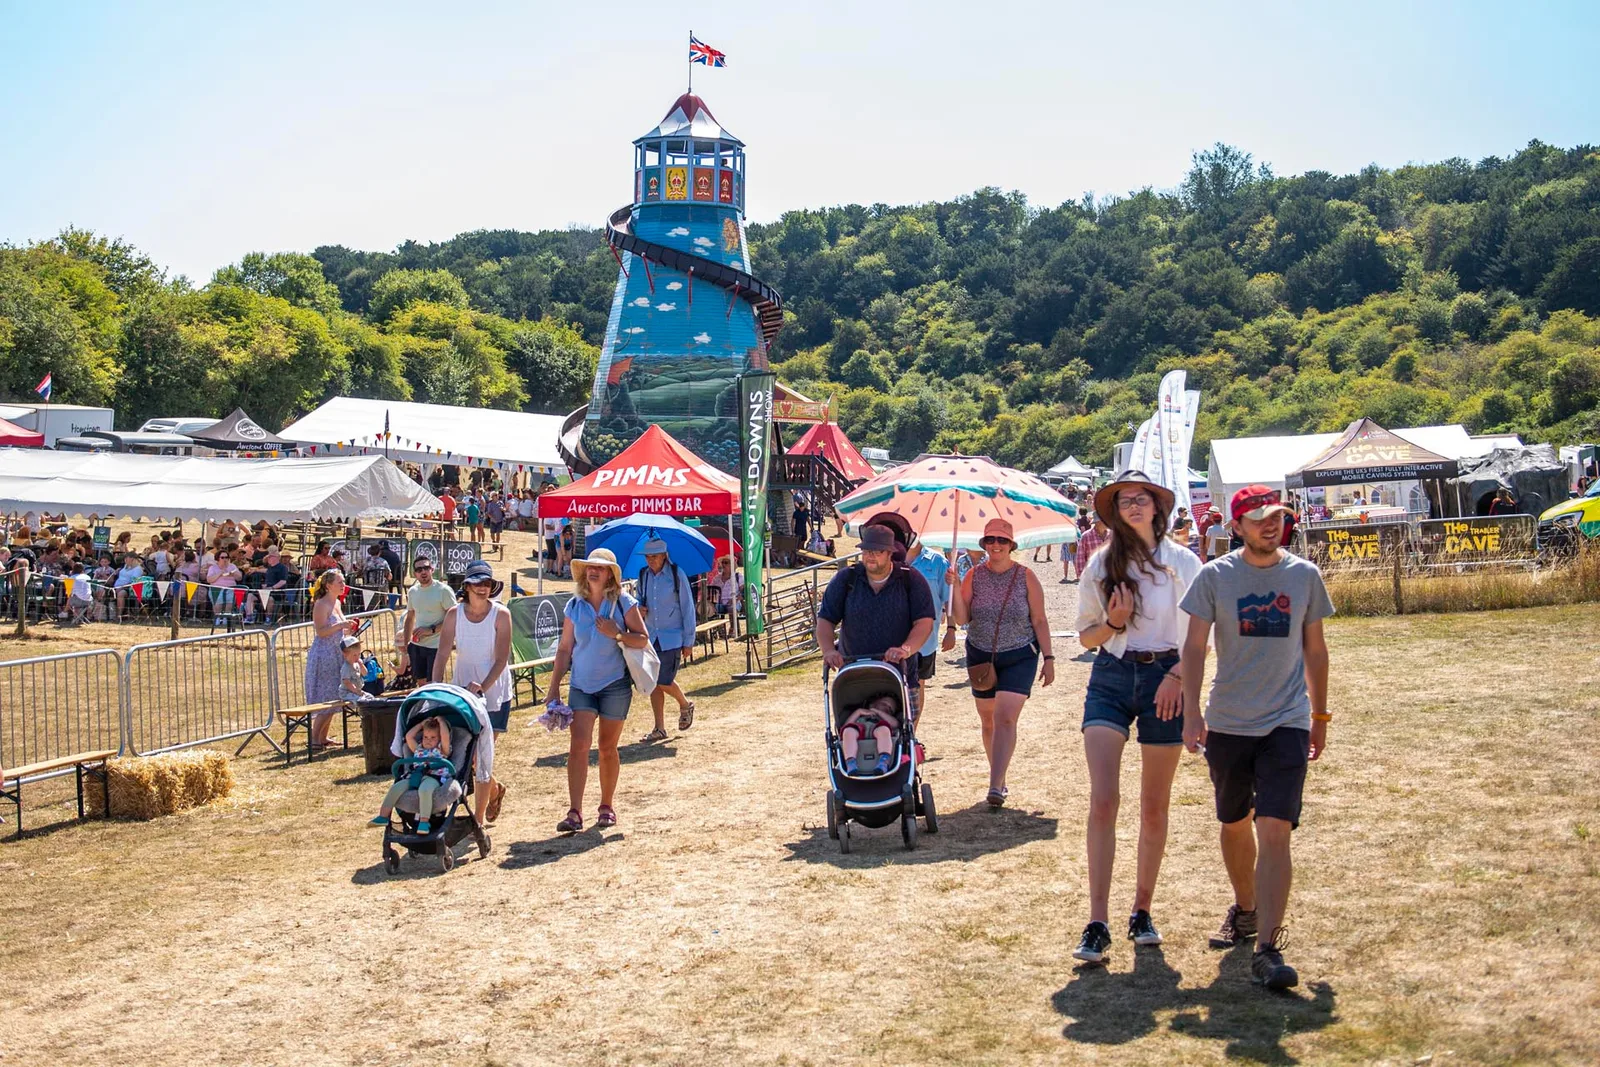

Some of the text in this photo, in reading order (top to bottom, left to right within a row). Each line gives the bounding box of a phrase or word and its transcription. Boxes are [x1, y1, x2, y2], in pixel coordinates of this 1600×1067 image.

[765, 388, 773, 423] SHOW
[748, 390, 764, 478] DOWNS
[236, 442, 282, 451] Awesome COFFEE
[1374, 444, 1411, 452] TRAILER
[1346, 451, 1412, 464] CAVE
[592, 464, 691, 489] PIMMS
[1315, 470, 1342, 478] EXPLORE
[1403, 463, 1443, 472] INTERACTIVE
[567, 497, 702, 515] Awesome PIMMS BAR
[1350, 534, 1378, 543] TRAILER
[1470, 527, 1500, 536] TRAILER
[1444, 534, 1501, 554] CAVE
[447, 549, 474, 559] FOOD
[1328, 542, 1380, 561] CAVE
[447, 561, 470, 572] ZON
